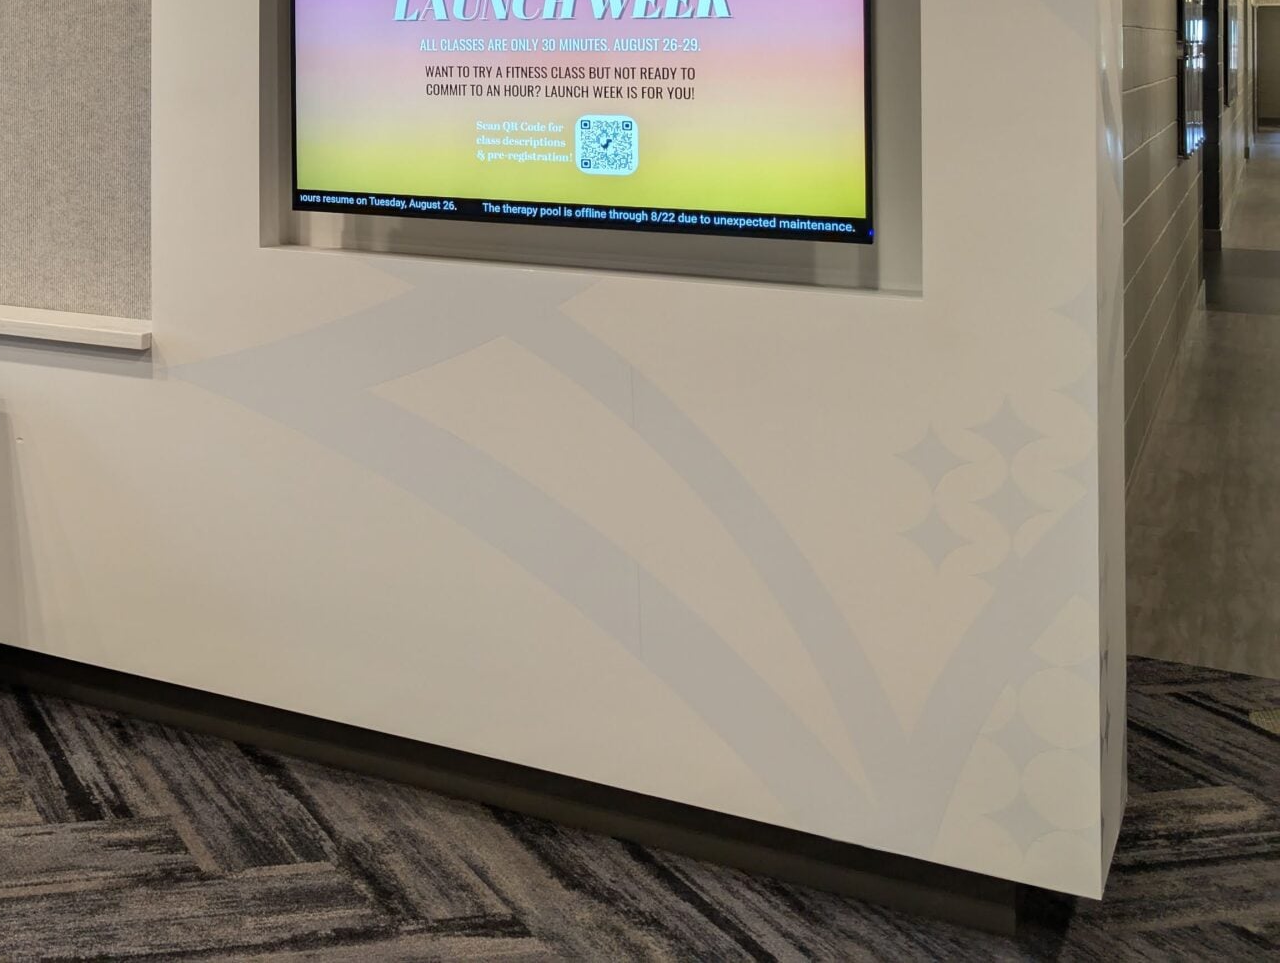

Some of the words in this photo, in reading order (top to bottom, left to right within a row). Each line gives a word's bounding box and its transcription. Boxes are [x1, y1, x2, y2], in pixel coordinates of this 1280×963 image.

[420, 39, 437, 51] ALL
[440, 39, 485, 52] CLASSES
[488, 39, 507, 52] ARE
[511, 39, 538, 52] ONLY
[542, 39, 556, 52] 30
[559, 38, 610, 52] MINUTES.
[614, 38, 659, 52] AUGUST
[663, 38, 701, 52] 26-29.
[425, 66, 453, 79] WANT
[457, 66, 470, 79] TO
[473, 66, 492, 79] TRY
[496, 66, 503, 79] A
[506, 66, 547, 79] FITNESS
[551, 66, 585, 79] CLASS
[589, 66, 611, 80] BUT
[615, 67, 636, 80] NOT
[640, 67, 676, 80] READY
[680, 67, 695, 80] TO
[426, 84, 467, 97] COMMIT
[470, 84, 483, 97] TO
[486, 84, 500, 97] AN
[504, 84, 541, 97] HOUR?
[545, 85, 589, 98] LAUNCH
[593, 85, 623, 98] WEEK
[627, 86, 637, 99] IS
[641, 86, 663, 99] FOR
[667, 86, 695, 100] YOU!
[476, 121, 500, 132] Scan
[503, 121, 518, 133] QR
[521, 122, 545, 132] Code
[548, 122, 564, 132] for
[476, 136, 500, 146] class
[503, 136, 566, 149] descriptions
[476, 151, 485, 161] &
[488, 151, 573, 163] pre-registration!
[323, 195, 354, 205] resume
[356, 197, 367, 205] on
[369, 196, 407, 209] Tuesday,
[409, 199, 439, 211] August
[442, 201, 458, 211] 26.
[482, 203, 500, 213] The
[503, 203, 537, 216] therapy
[540, 205, 561, 217] pool
[563, 207, 572, 217] is
[575, 208, 606, 219] offline
[609, 209, 647, 223] through
[651, 212, 675, 223] 8/22
[678, 213, 697, 224] due
[701, 214, 710, 224] to
[714, 215, 776, 229] unexpected
[779, 218, 856, 232] maintenance.
